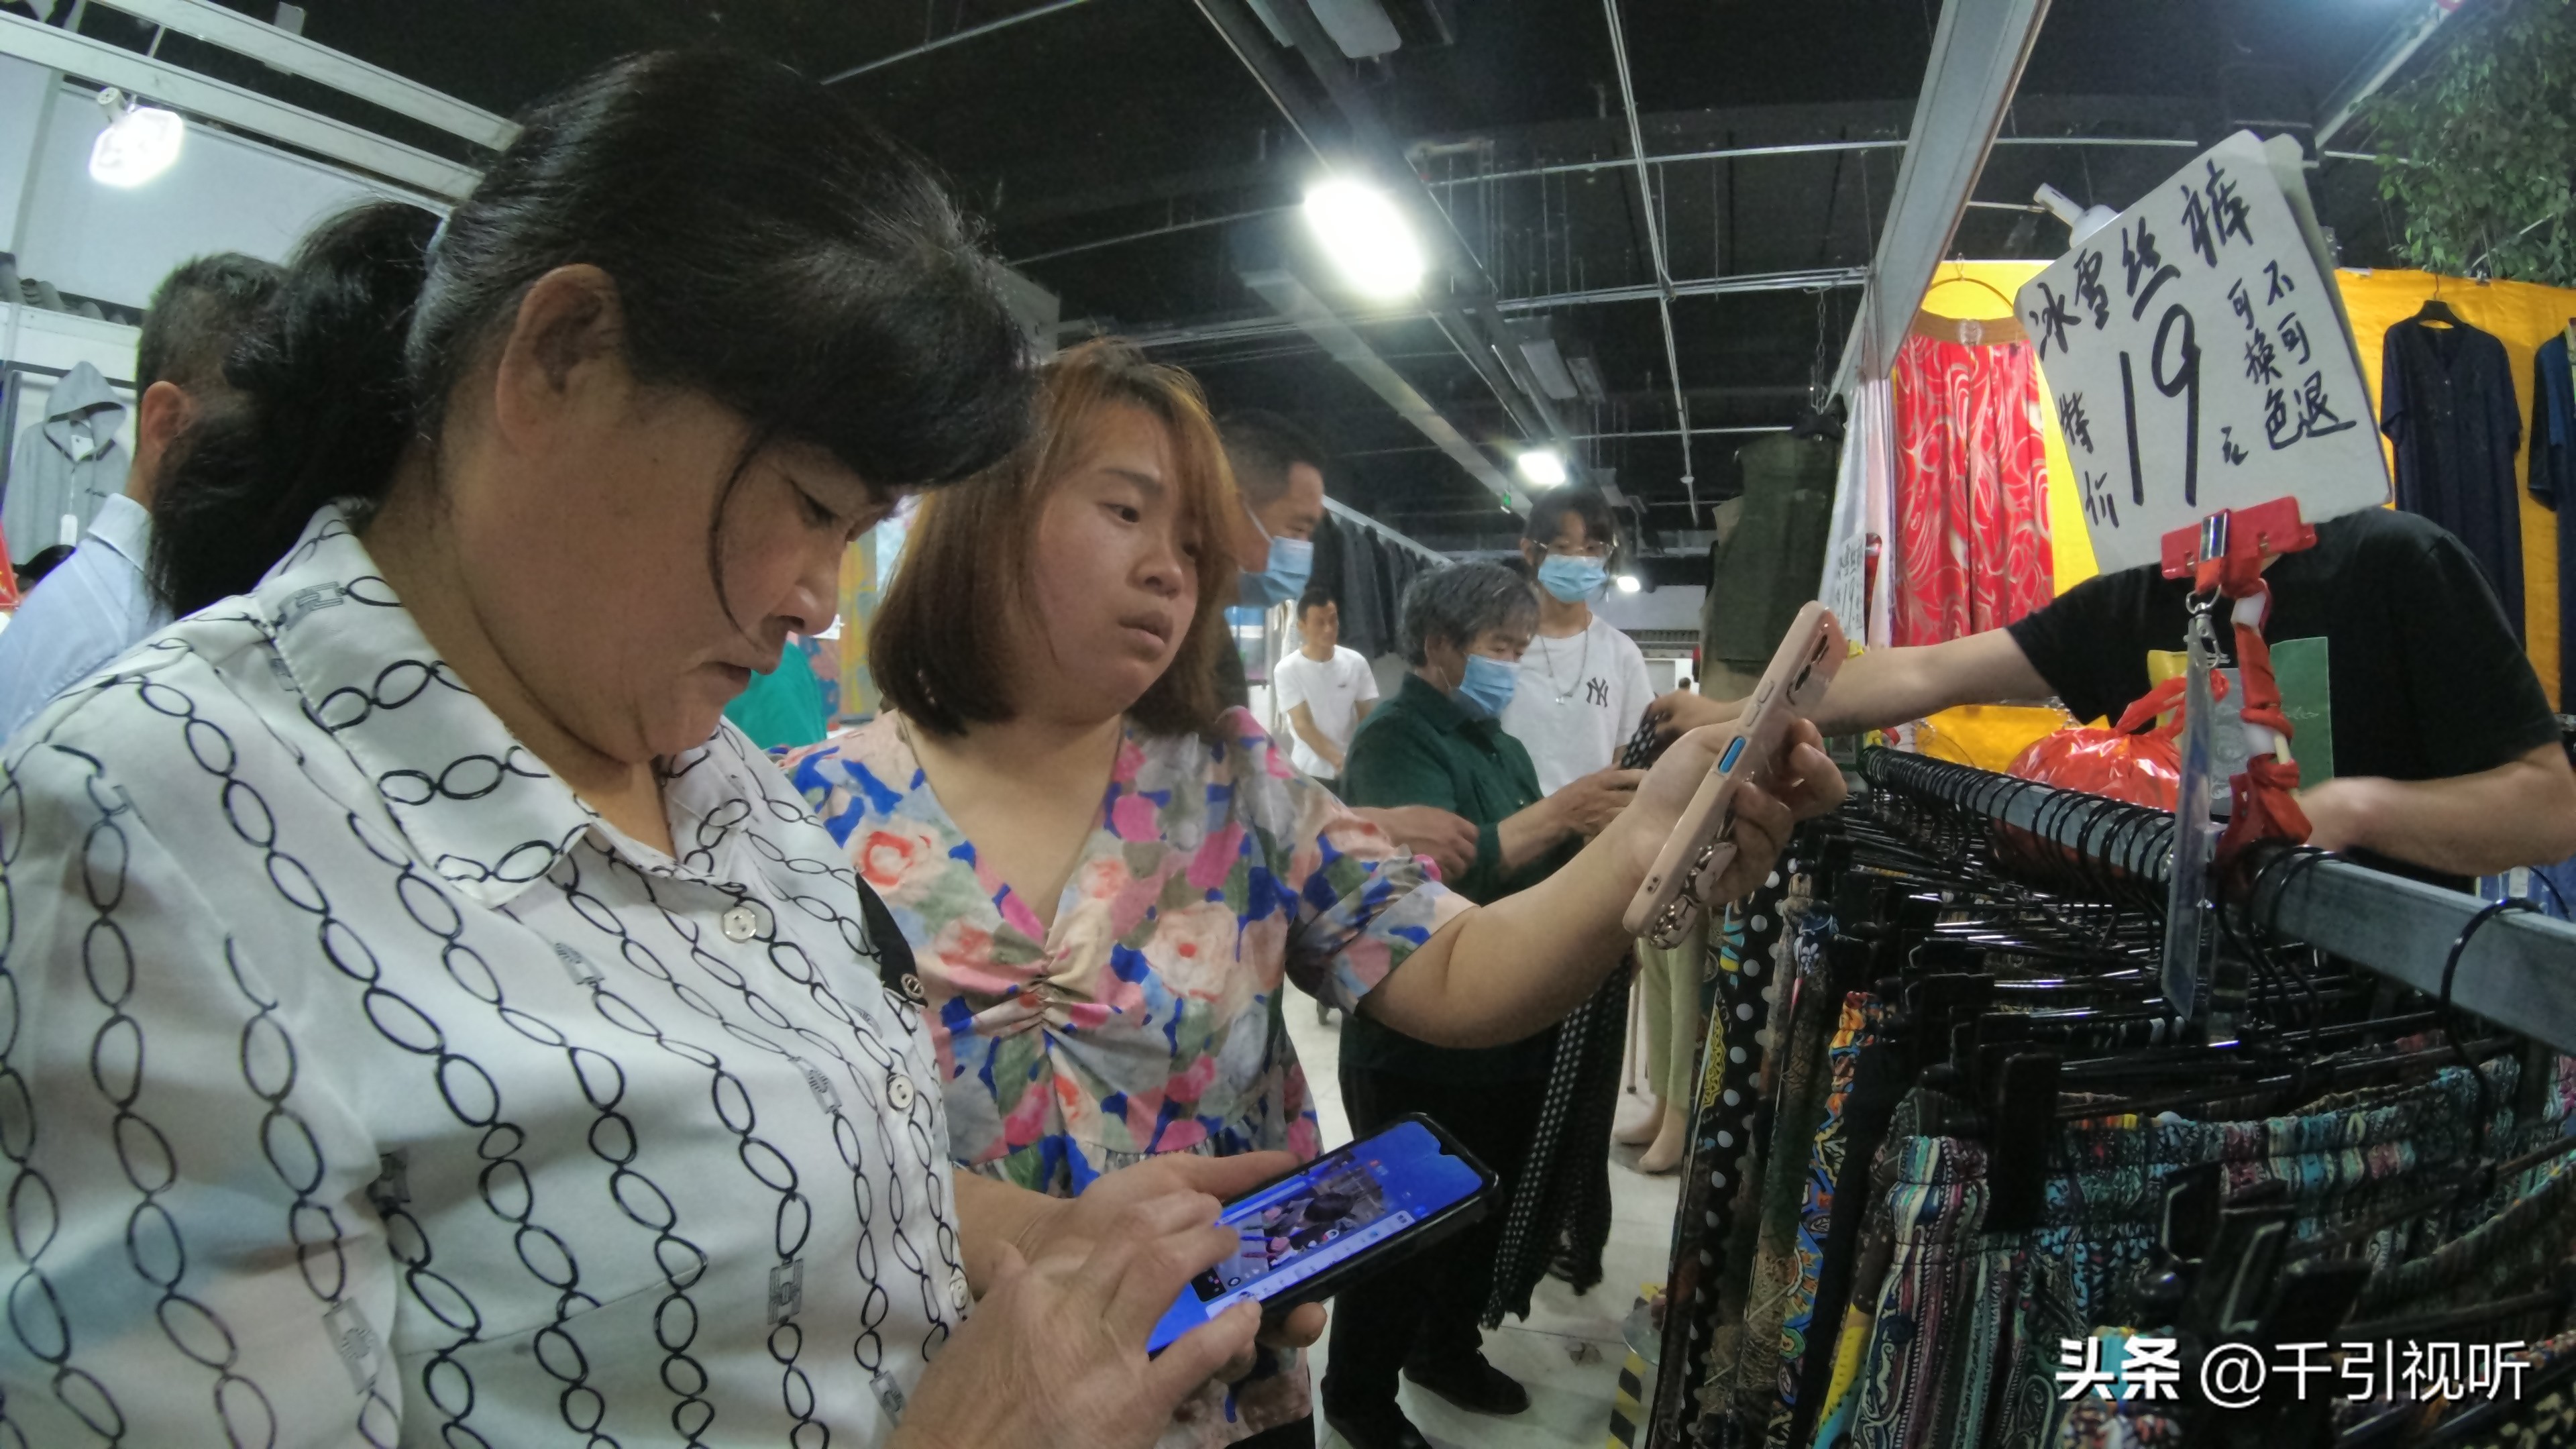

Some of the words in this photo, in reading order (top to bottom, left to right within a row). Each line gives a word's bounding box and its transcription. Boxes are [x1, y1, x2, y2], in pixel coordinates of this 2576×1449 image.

[2029, 158, 2254, 362] 冰雪丝裤
[2118, 303, 2202, 508] 19
[2227, 278, 2302, 450] 可换色
[2263, 260, 2357, 438] 不可退
[2059, 390, 2120, 529] 特价
[1586, 676, 1609, 708] NY
